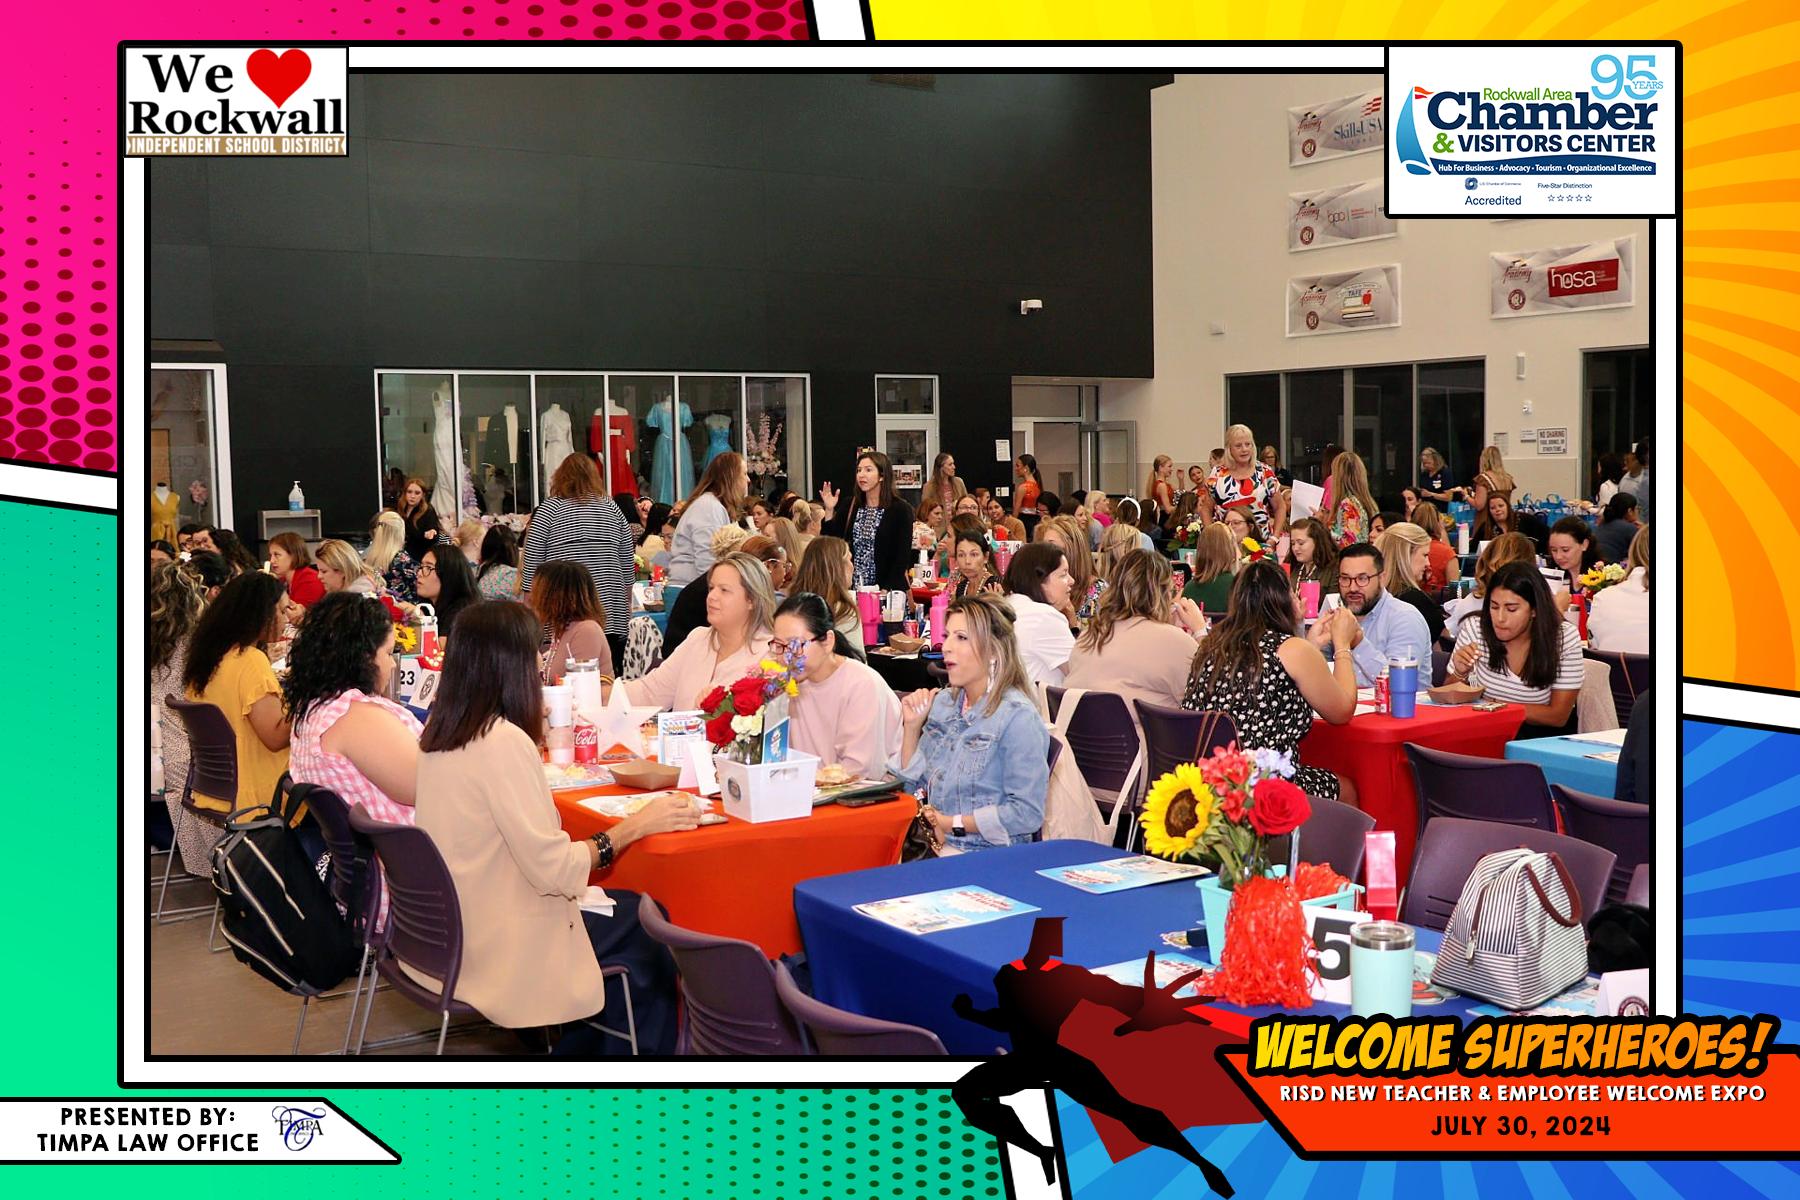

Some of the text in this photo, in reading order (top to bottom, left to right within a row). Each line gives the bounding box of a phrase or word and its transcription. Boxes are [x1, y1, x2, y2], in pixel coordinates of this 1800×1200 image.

[1551, 268, 1598, 289] hosa
[400, 670, 415, 686] 23
[575, 728, 597, 746] Cola
[1312, 916, 1352, 981] 5
